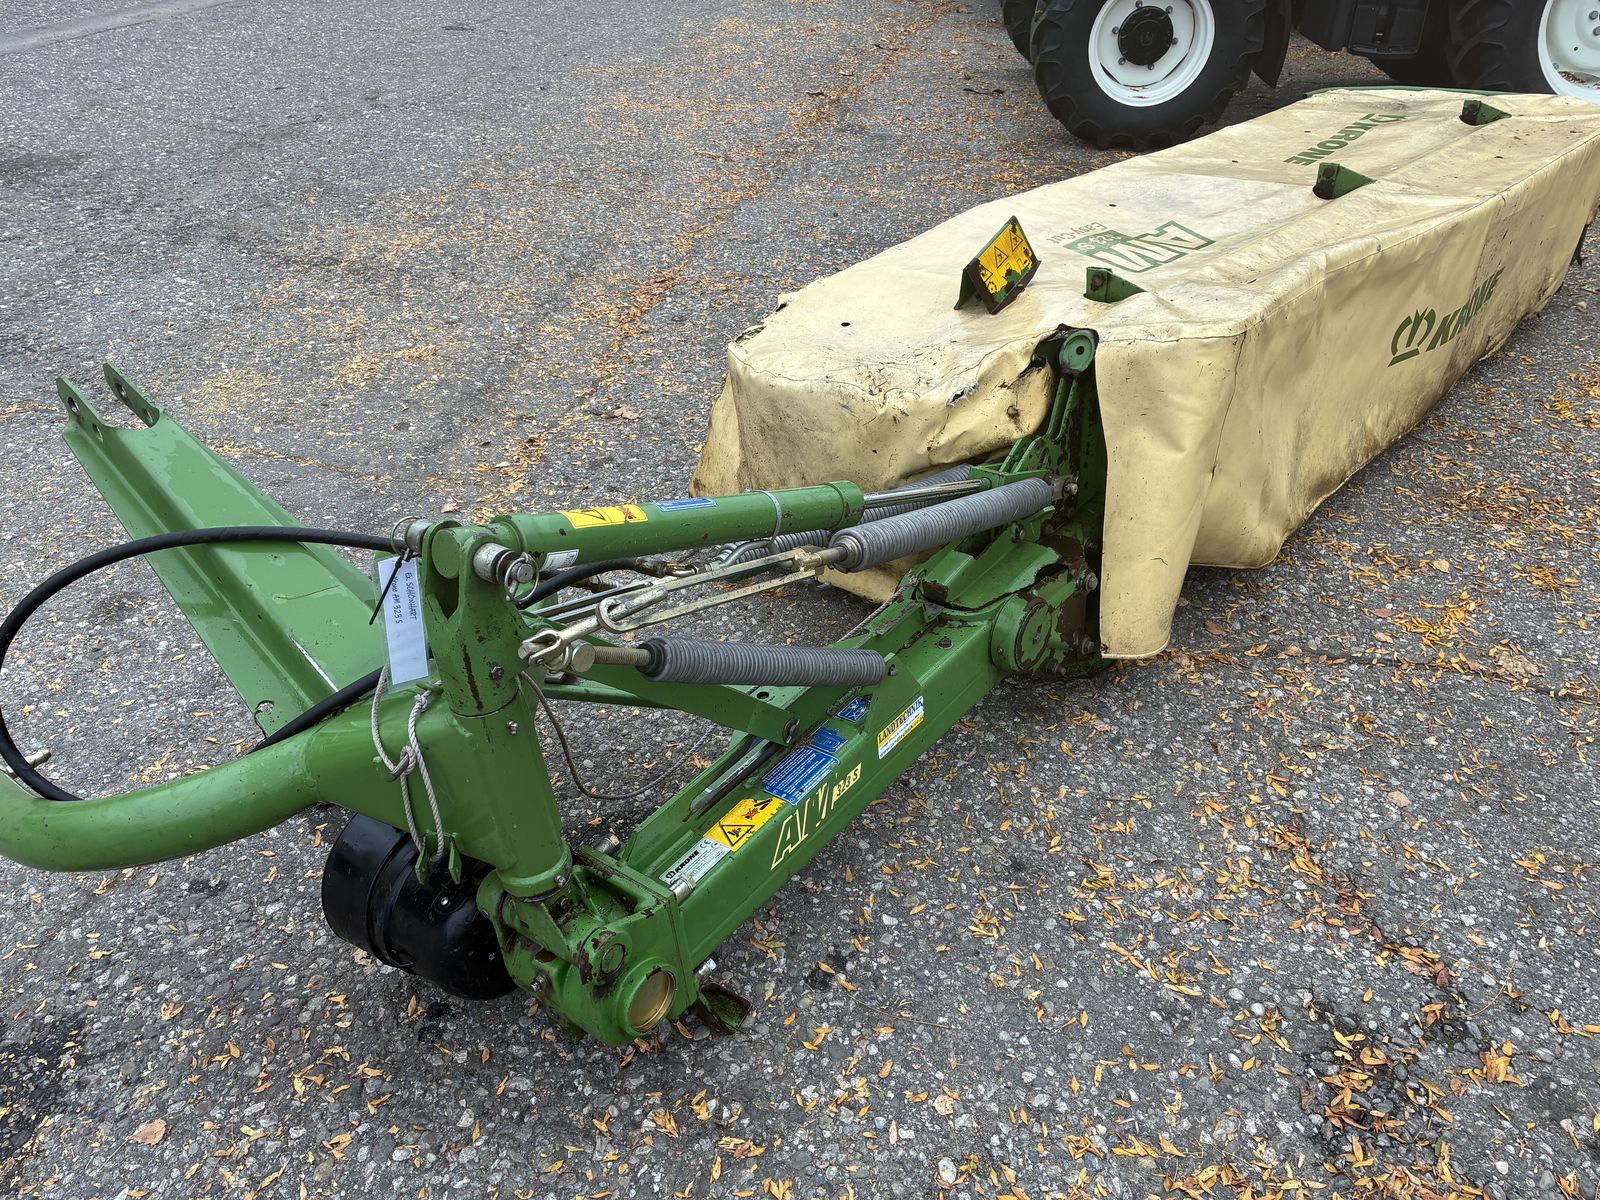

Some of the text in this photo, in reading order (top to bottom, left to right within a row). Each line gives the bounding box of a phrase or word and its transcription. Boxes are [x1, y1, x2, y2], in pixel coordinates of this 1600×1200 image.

[1283, 121, 1379, 167] KRONE
[1046, 221, 1109, 245] Easy-Cut
[1088, 220, 1216, 273] AM
[1425, 265, 1506, 353] KRONE
[393, 604, 403, 619] 323
[878, 698, 924, 744] LANDTECHNIK
[674, 849, 700, 874] KRONE
